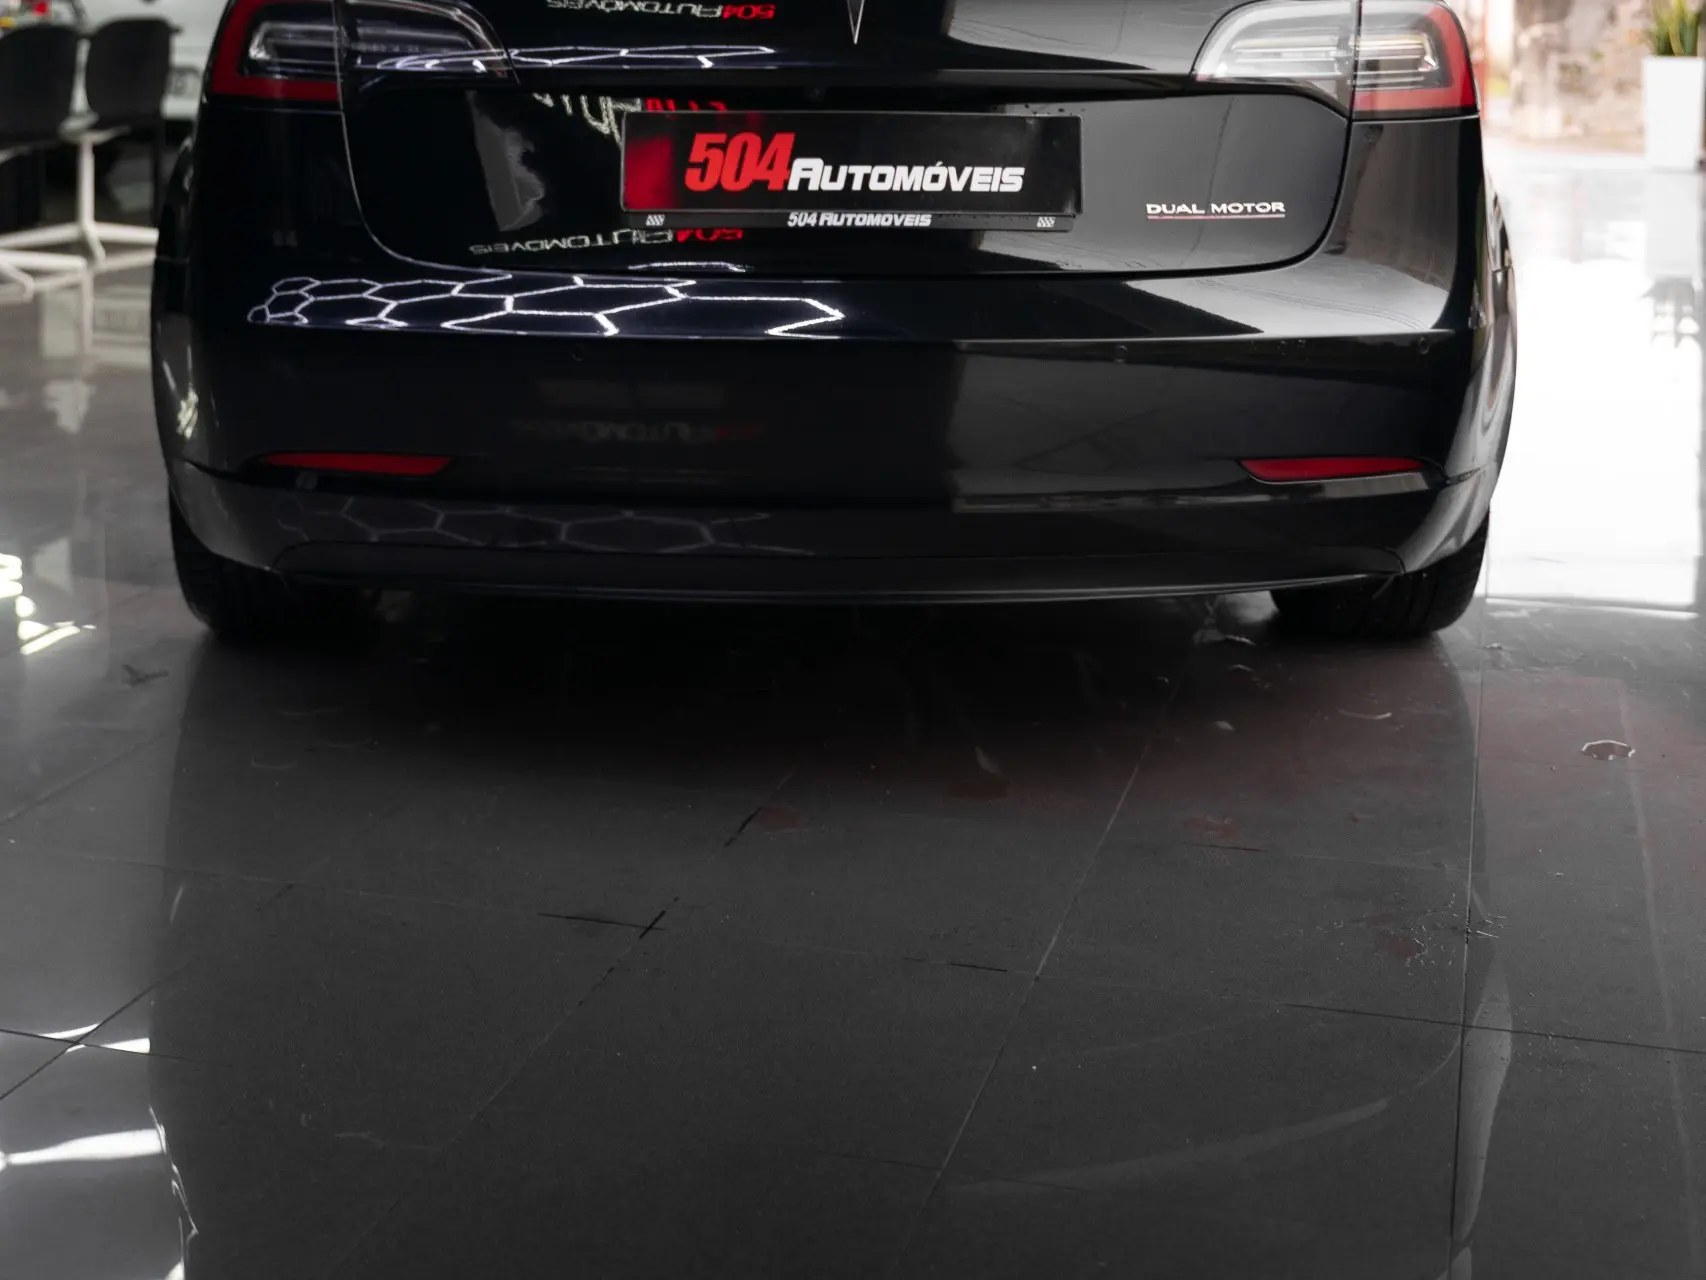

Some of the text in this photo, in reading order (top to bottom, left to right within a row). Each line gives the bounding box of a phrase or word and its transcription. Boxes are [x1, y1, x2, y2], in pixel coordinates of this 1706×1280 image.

[684, 132, 795, 191] 504
[1146, 201, 1286, 215] DUAL MOTOR
[787, 211, 817, 227] 504
